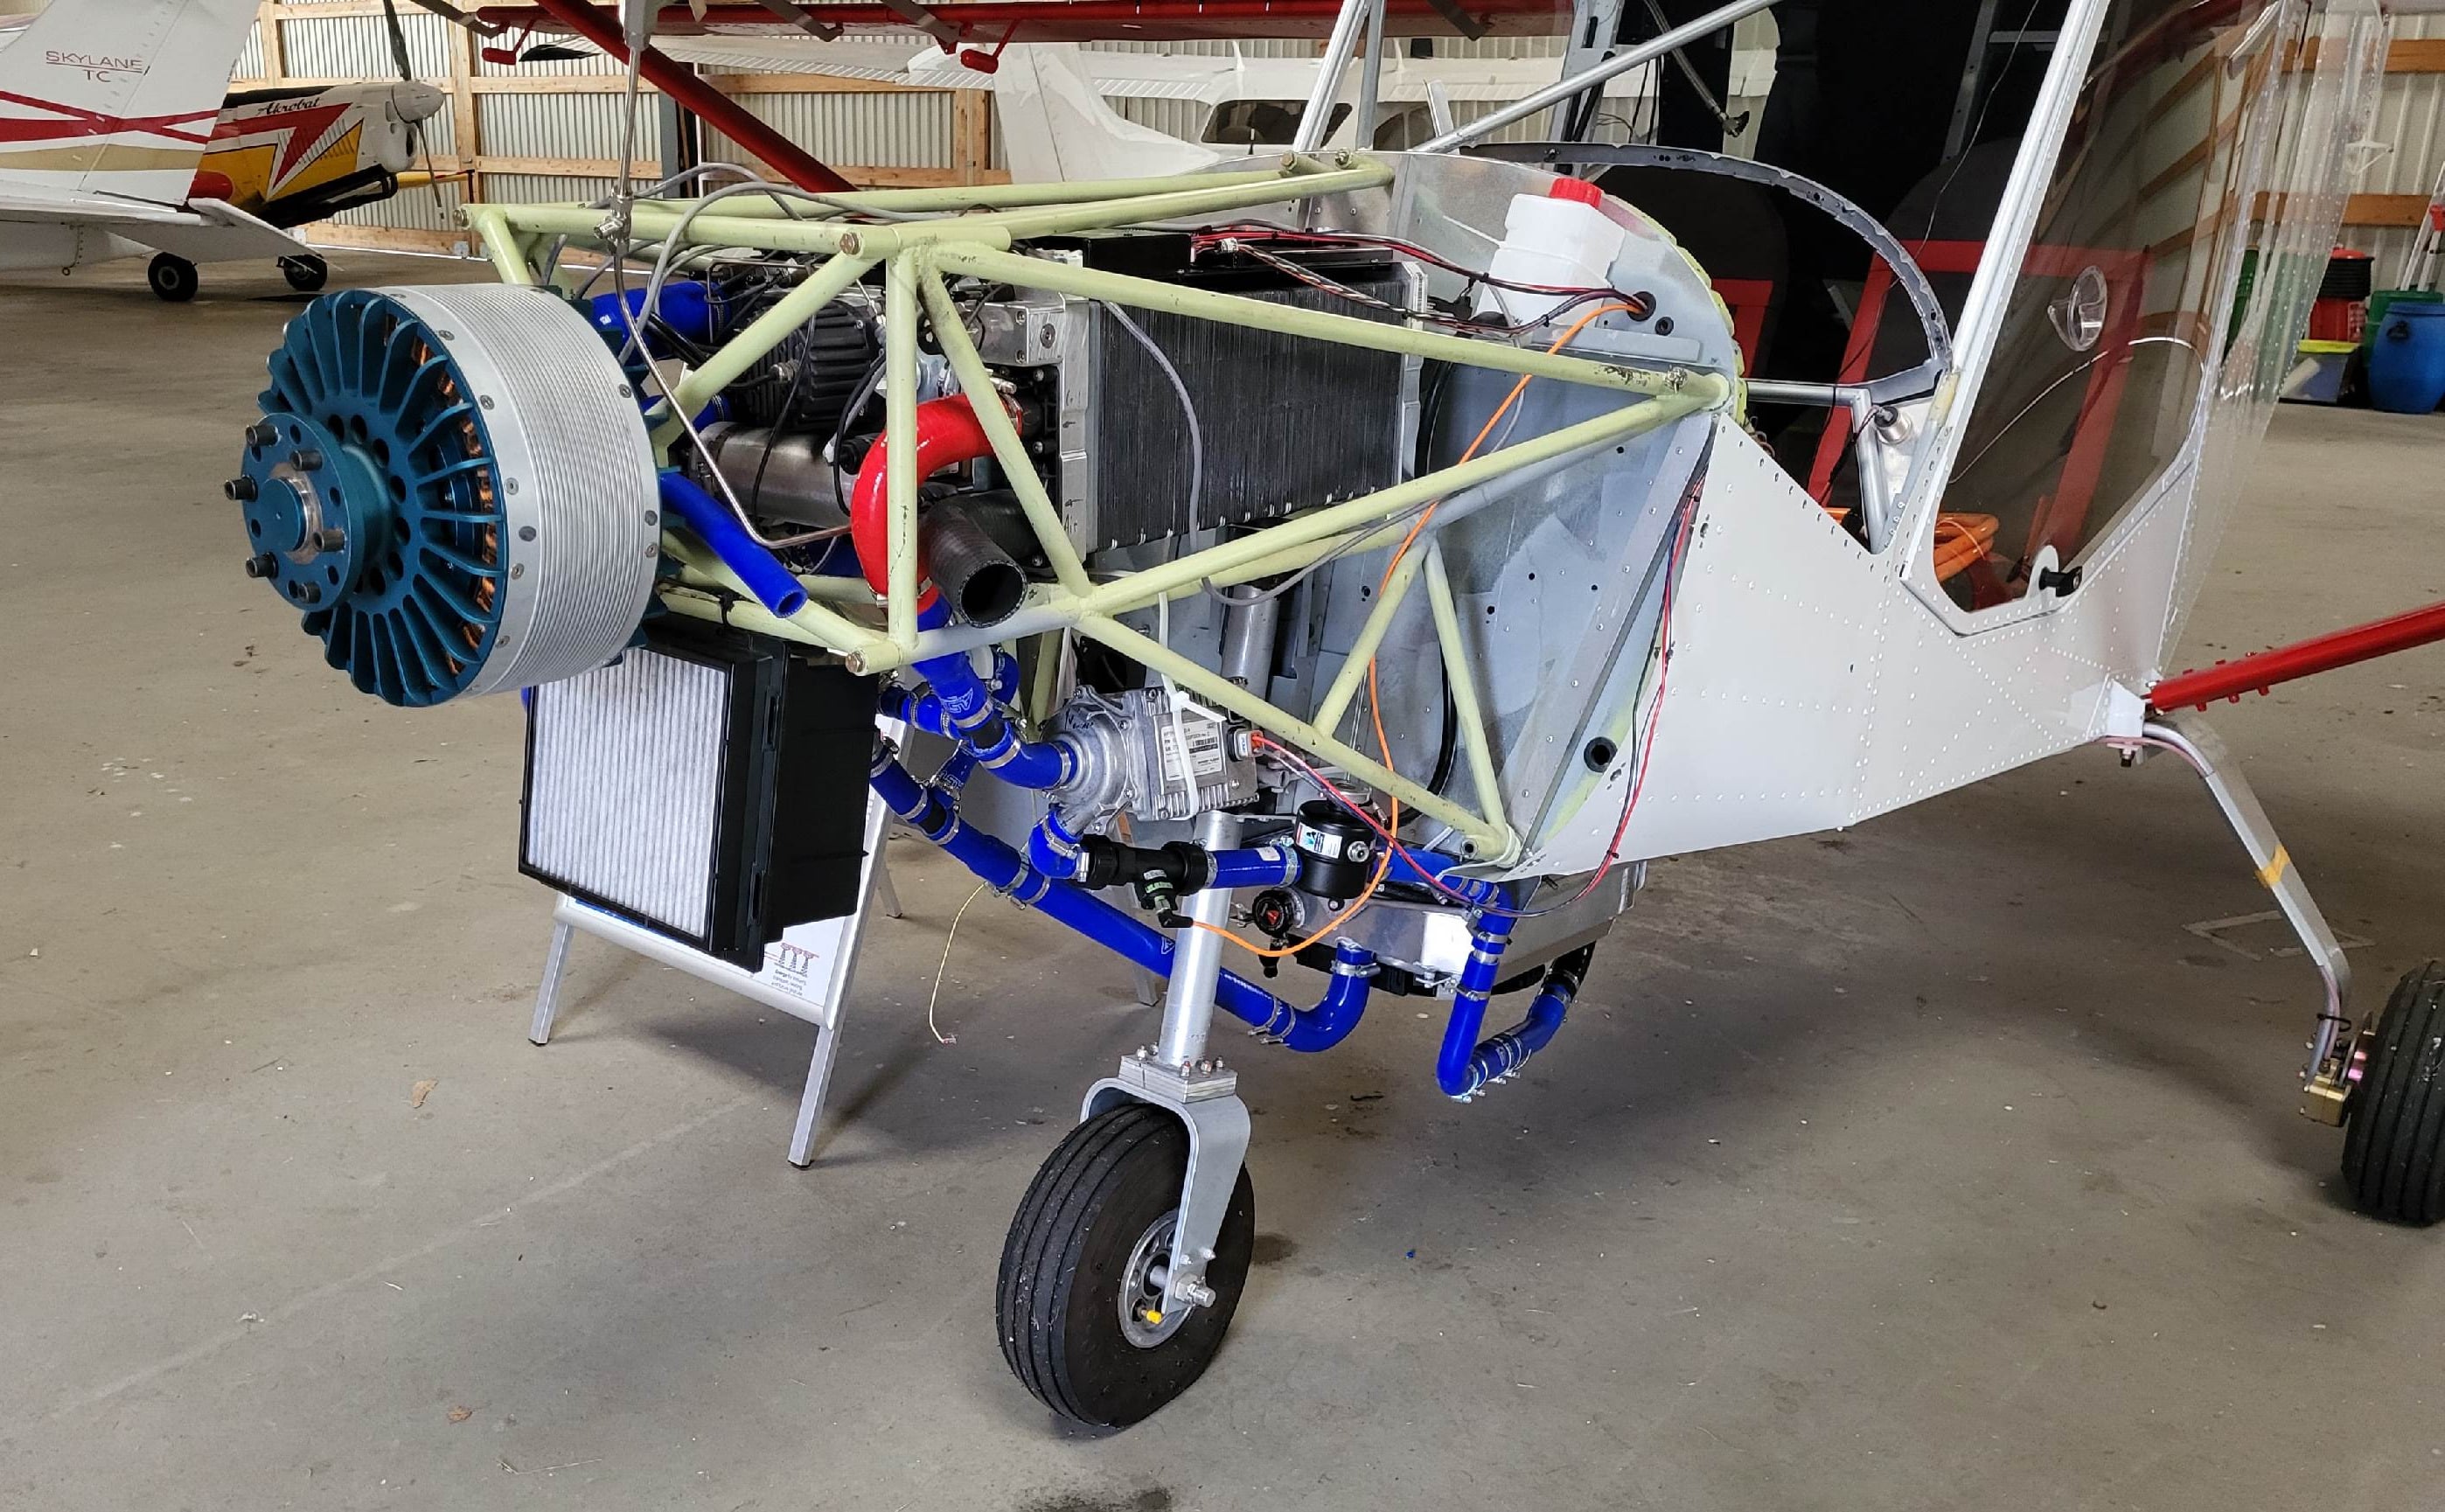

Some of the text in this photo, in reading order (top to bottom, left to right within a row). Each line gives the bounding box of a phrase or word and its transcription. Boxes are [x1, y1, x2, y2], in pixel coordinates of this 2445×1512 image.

[45, 50, 143, 71] SKYLANE
[83, 69, 111, 83] TC
[256, 97, 321, 115] Akrobat
[1063, 513, 1078, 535] Air
